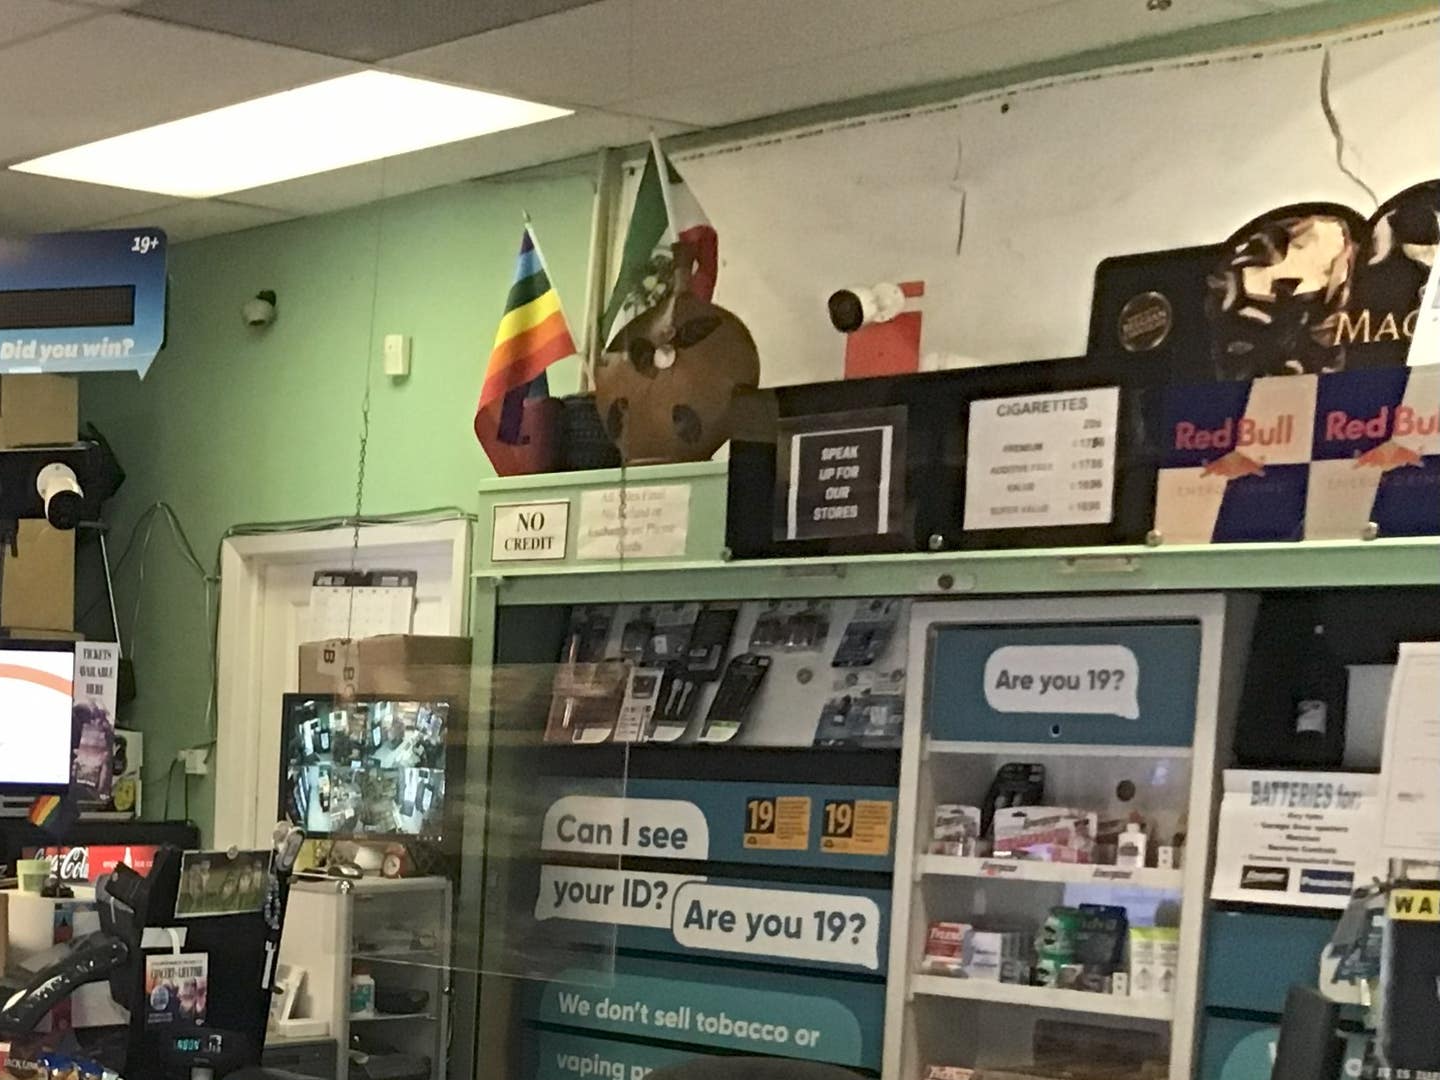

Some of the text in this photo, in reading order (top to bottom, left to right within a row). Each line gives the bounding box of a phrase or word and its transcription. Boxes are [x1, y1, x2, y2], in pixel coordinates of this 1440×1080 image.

[131, 237, 159, 254] 19+
[0, 337, 135, 362] Did you win?
[997, 397, 1088, 417] CIGARETTES
[1175, 414, 1294, 450] Red Bull
[1326, 406, 1389, 441] Red
[517, 511, 545, 533] NO
[504, 536, 555, 552] CREDIT
[995, 669, 1125, 695] Are you 19?
[1250, 780, 1334, 809] BATTERIES
[748, 801, 775, 831] 19
[824, 801, 852, 834] 19
[556, 815, 689, 850] Can I see
[553, 878, 668, 909] your ID?
[1394, 896, 1440, 914] WA
[683, 899, 867, 945] Are you 19?
[558, 991, 820, 1048] We don't sell tobacco or
